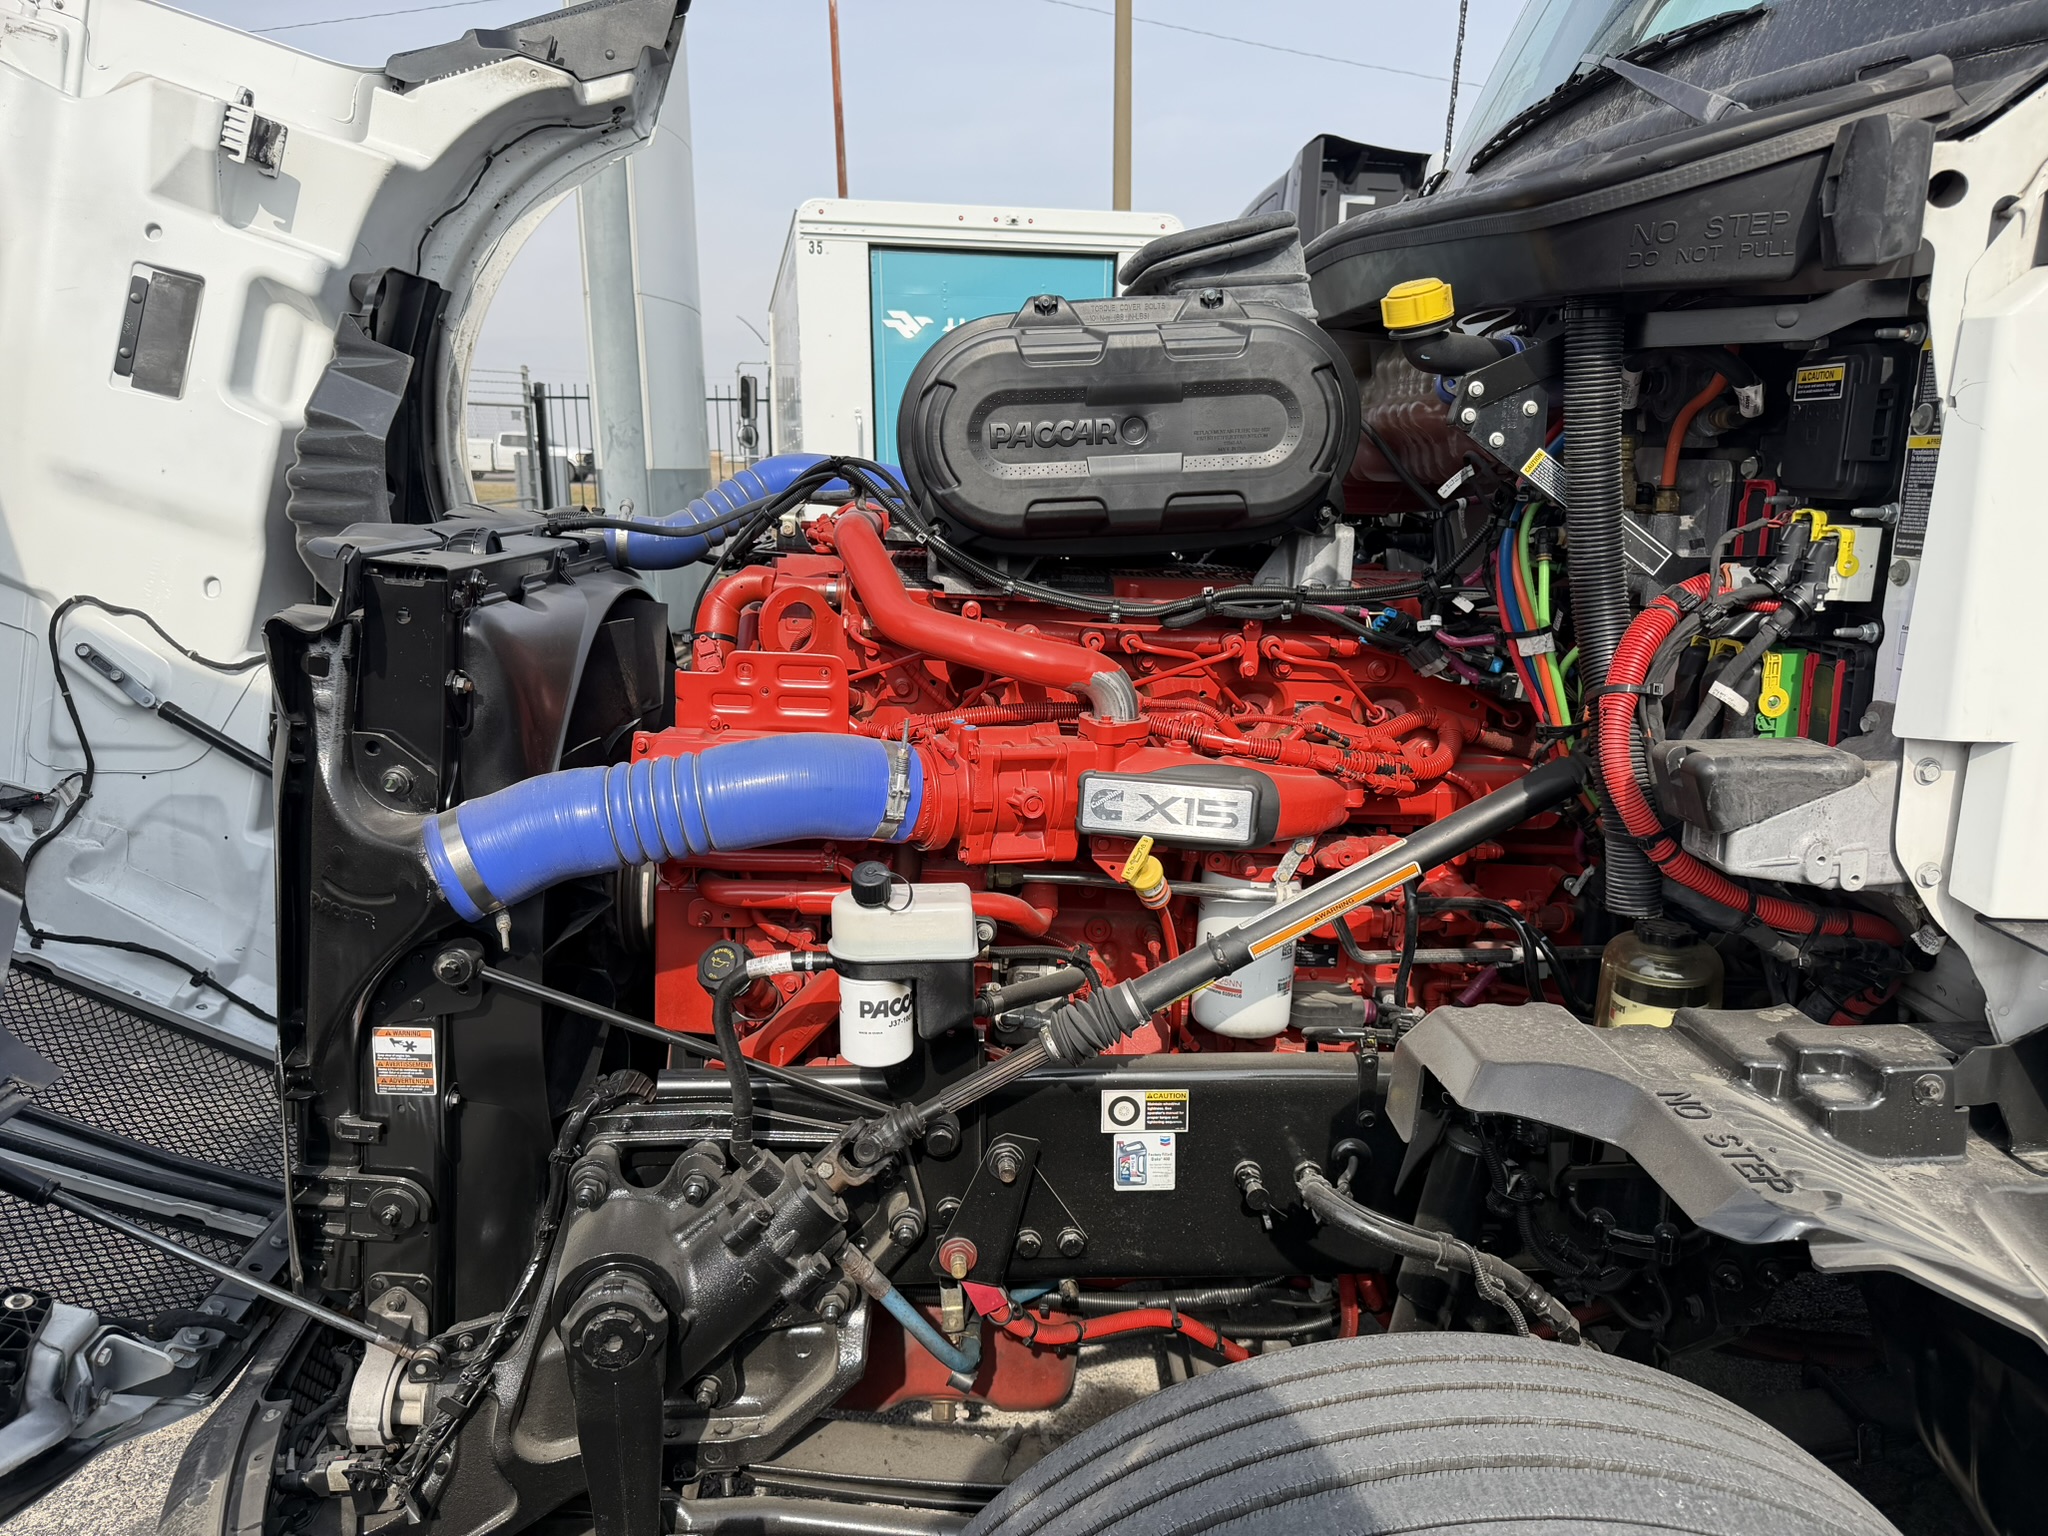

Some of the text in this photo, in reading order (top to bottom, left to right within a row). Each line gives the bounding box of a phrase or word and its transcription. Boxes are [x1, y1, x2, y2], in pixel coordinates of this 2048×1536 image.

[1629, 210, 1792, 247] NO STEP
[808, 240, 823, 255] 35
[1625, 239, 1795, 269] DO NOT PULL
[1091, 302, 1166, 313] TORQUE COVER BOLTS
[1807, 370, 1835, 382] CAUTION
[989, 417, 1118, 450] PACCAR
[1524, 451, 1543, 473] CAUTION
[1134, 793, 1239, 830] X15
[1318, 897, 1355, 919] WARNING
[714, 948, 735, 960] ENGINE
[1656, 1090, 1794, 1194] NO STEP
